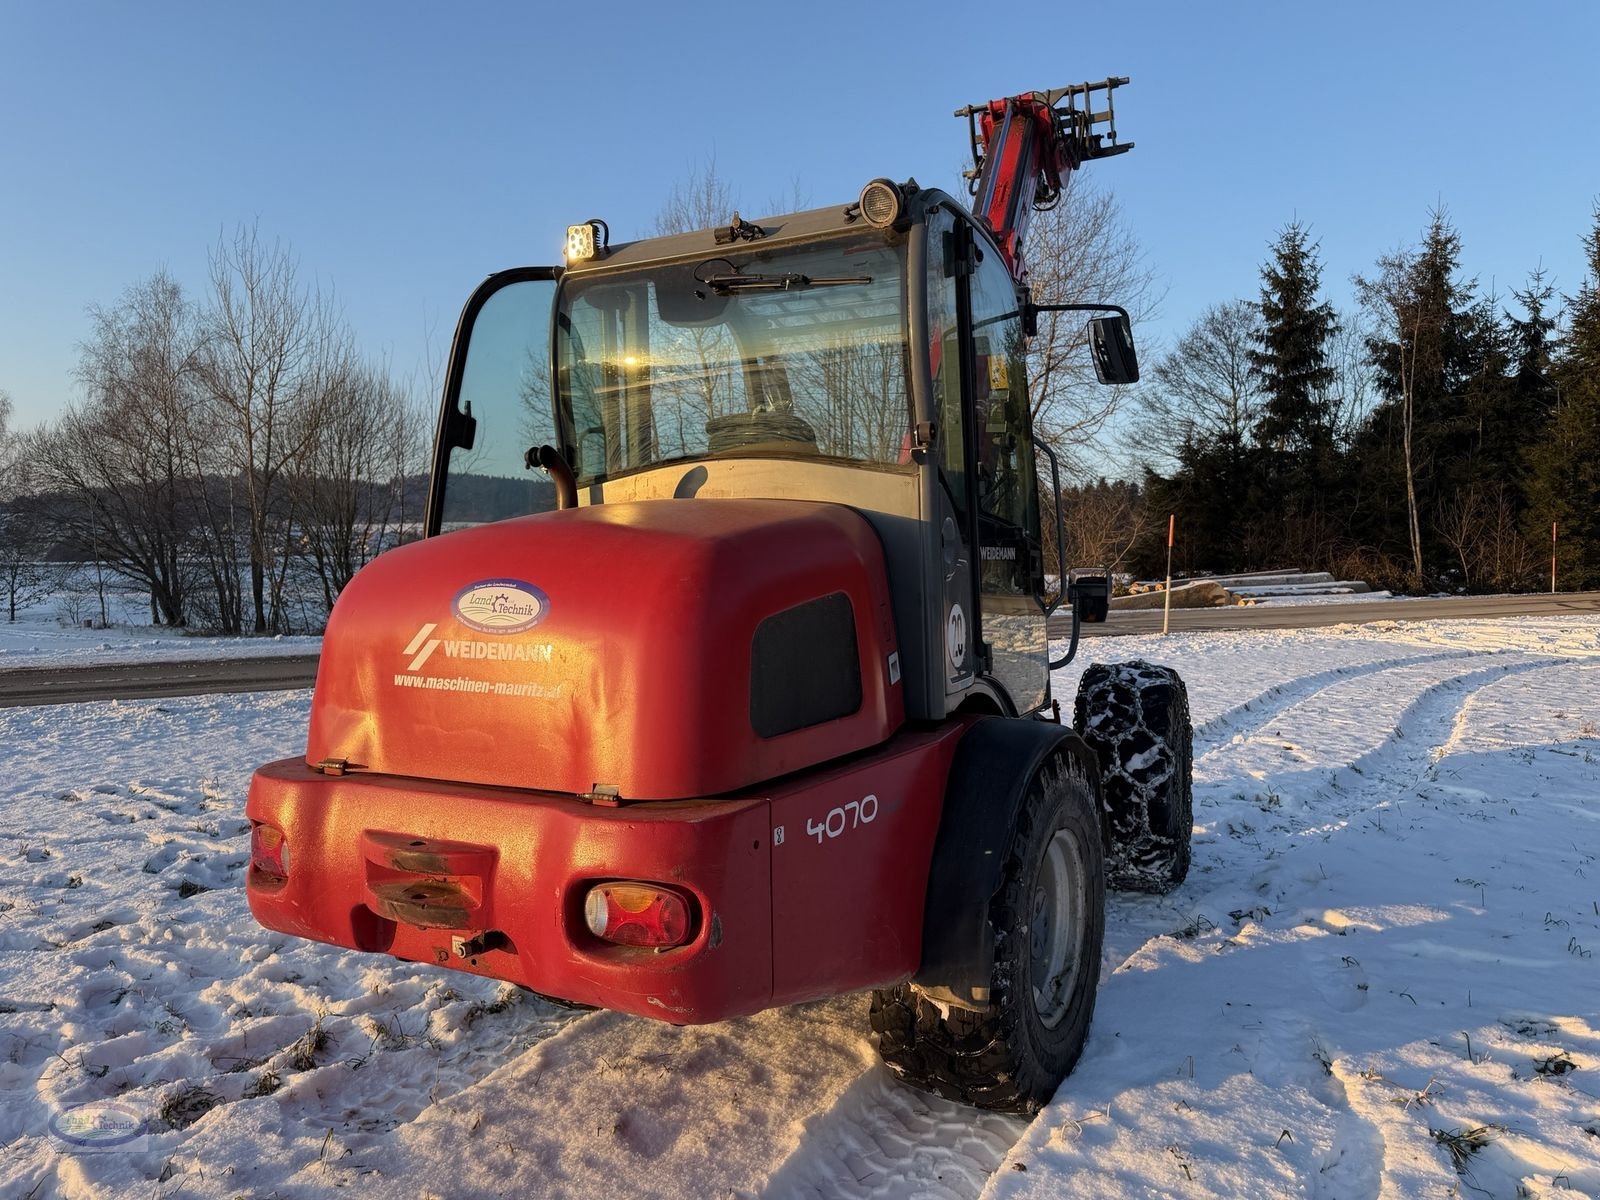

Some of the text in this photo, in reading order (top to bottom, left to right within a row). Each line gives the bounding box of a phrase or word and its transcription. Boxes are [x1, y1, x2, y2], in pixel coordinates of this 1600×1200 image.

[980, 546, 1016, 560] WEIDEMANN
[469, 593, 493, 606] Land
[498, 603, 534, 616] Technik
[443, 639, 553, 663] WEIDEMANN
[806, 794, 879, 844] 4070
